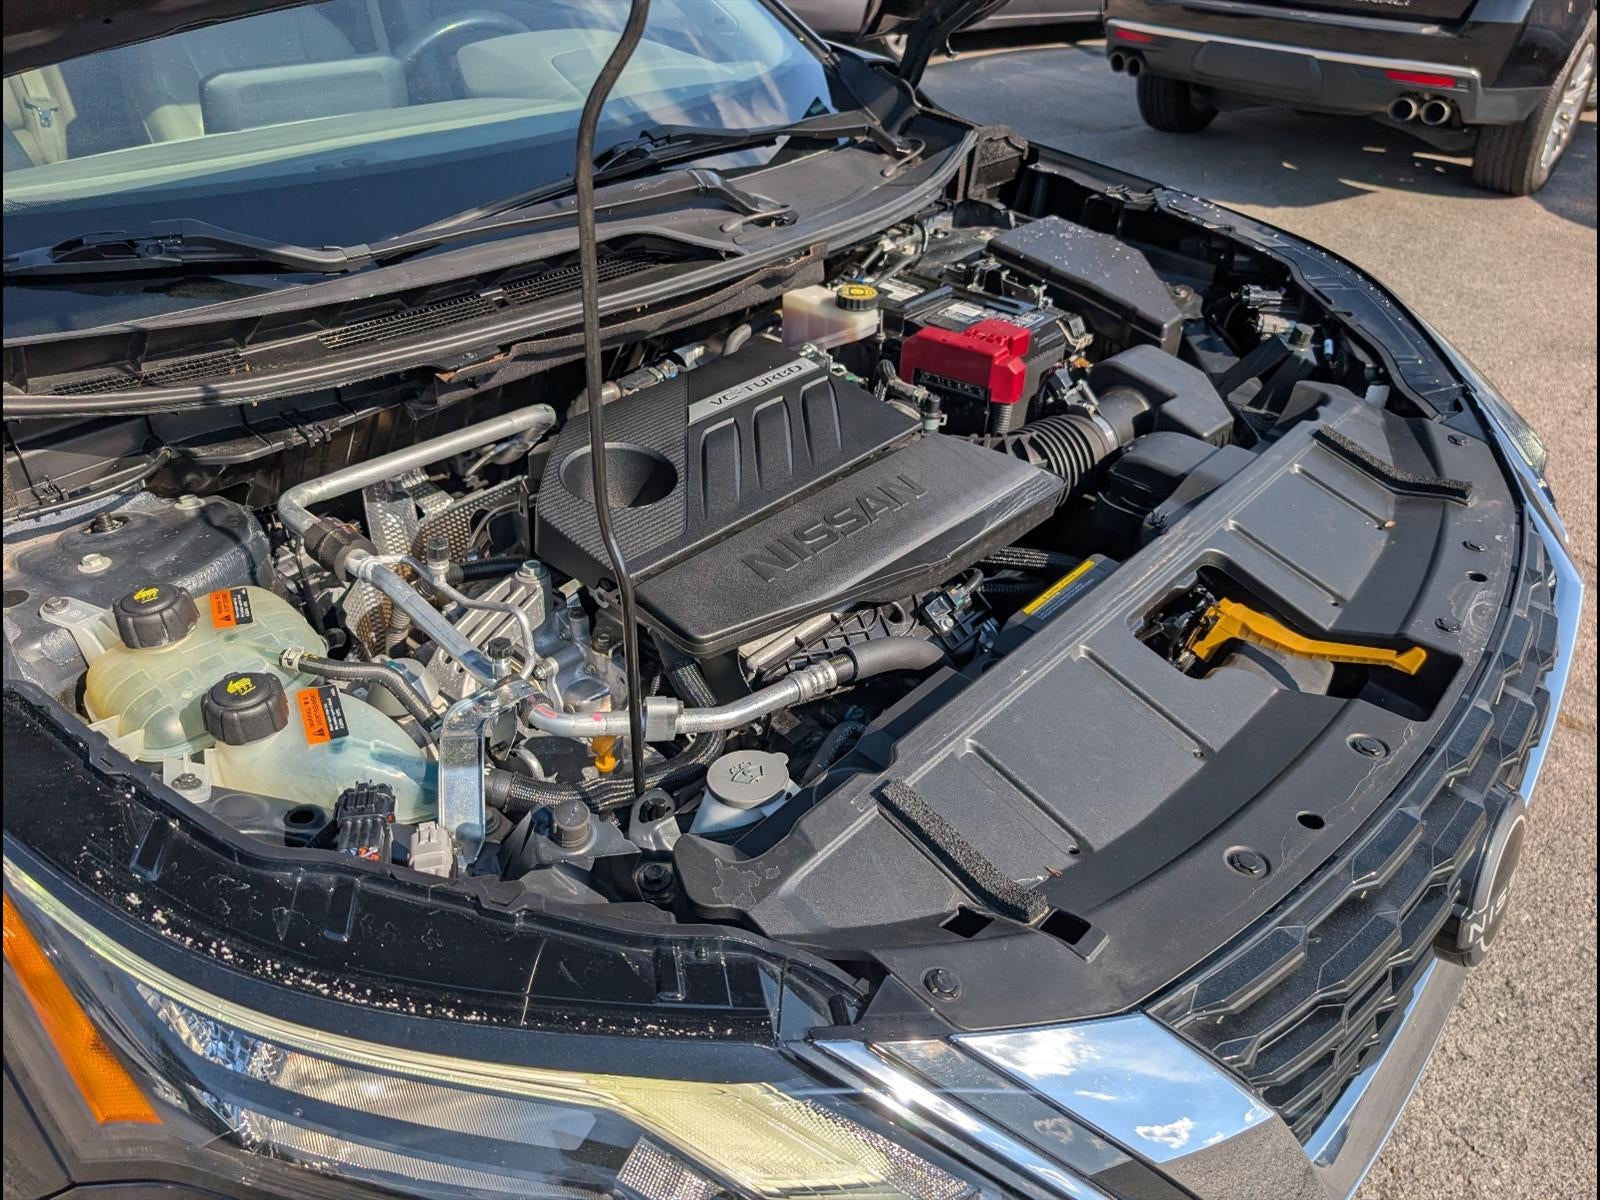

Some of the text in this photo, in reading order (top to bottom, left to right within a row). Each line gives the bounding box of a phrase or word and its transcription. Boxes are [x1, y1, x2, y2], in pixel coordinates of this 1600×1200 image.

[709, 365, 802, 406] VC-TURBO
[741, 475, 928, 583] NISSAN
[1468, 883, 1512, 944] NIS
